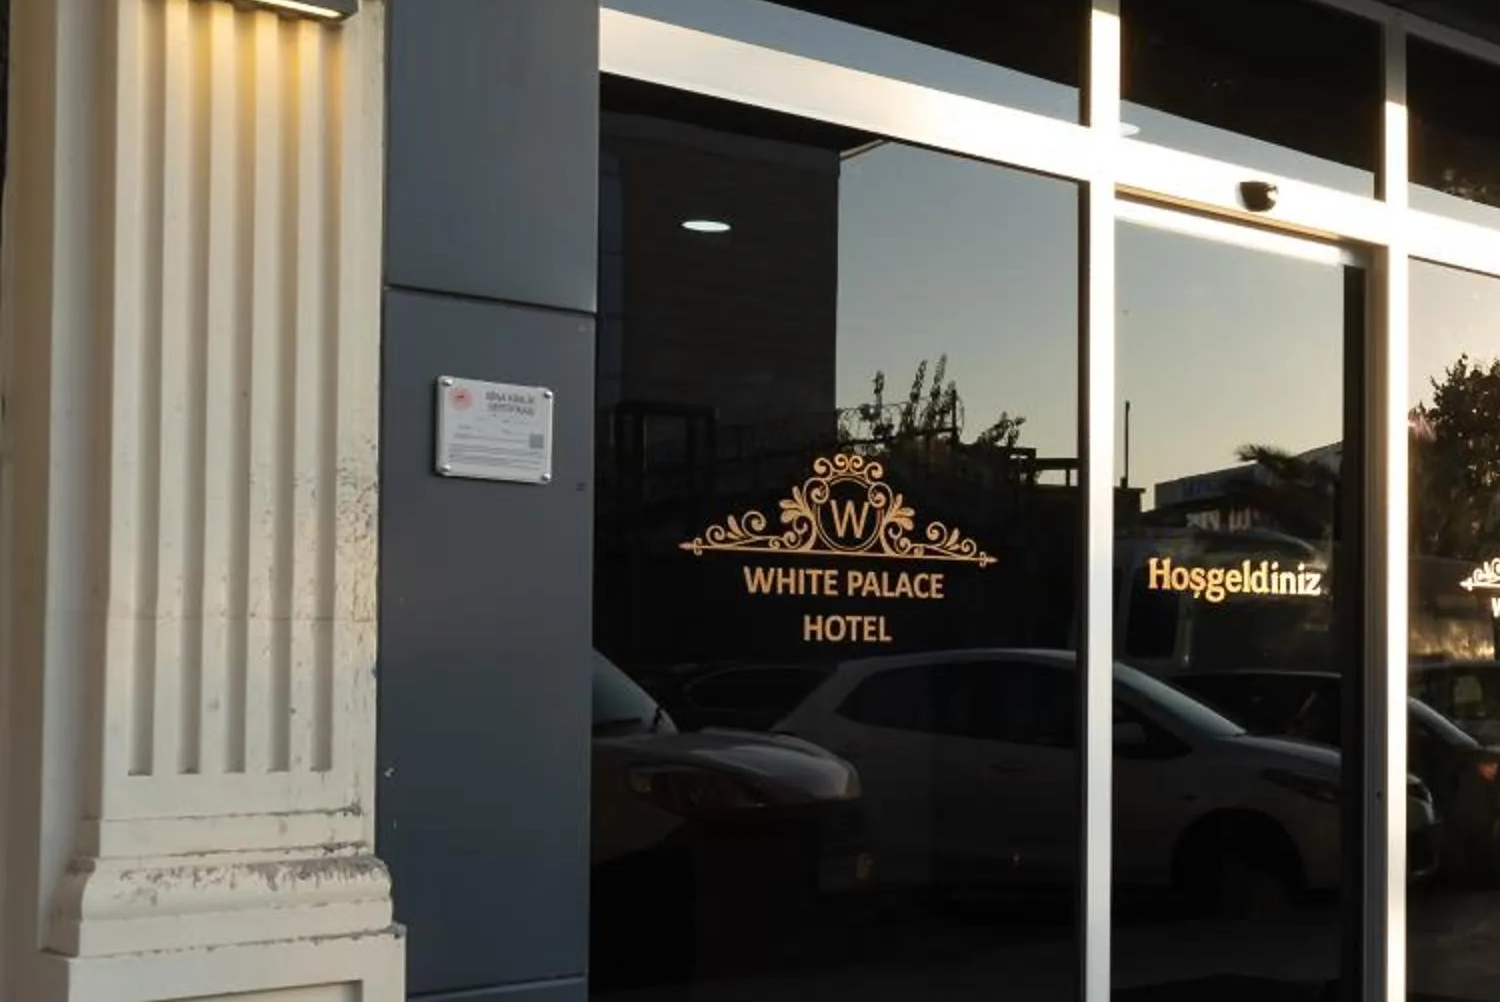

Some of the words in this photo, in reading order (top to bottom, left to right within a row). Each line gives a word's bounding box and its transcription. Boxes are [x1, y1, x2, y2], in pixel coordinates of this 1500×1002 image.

[830, 499, 870, 539] W
[743, 565, 840, 597] WHITE
[846, 570, 945, 599] PALACE
[1148, 557, 1322, 603] Hoşgeldiniz
[803, 614, 893, 642] HOTEL
